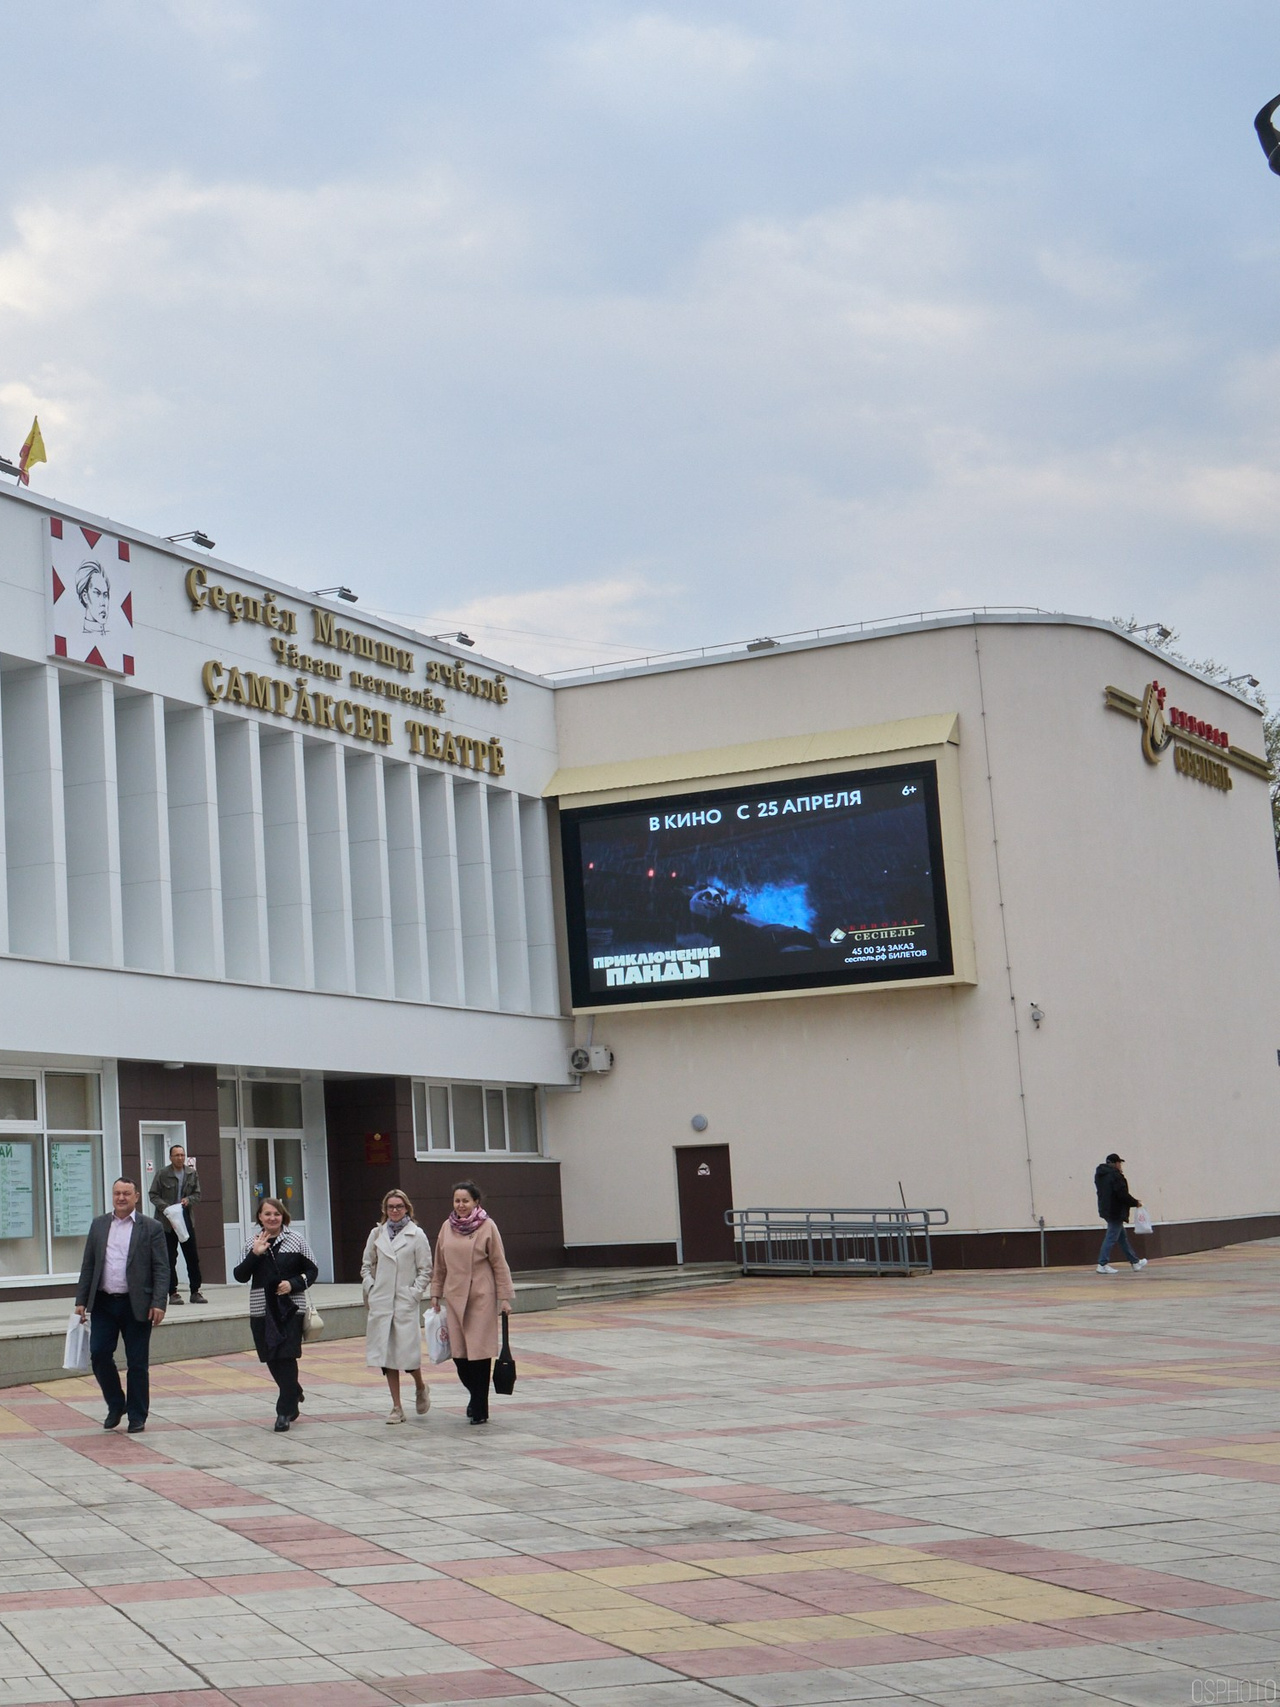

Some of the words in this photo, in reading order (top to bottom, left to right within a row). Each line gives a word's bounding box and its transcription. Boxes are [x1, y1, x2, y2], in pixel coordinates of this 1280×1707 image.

[311, 607, 415, 673] Мишши
[901, 785, 917, 796] 6+
[649, 816, 660, 832] В
[664, 809, 722, 830] КИНО
[736, 804, 750, 820] С
[757, 800, 779, 818] 25
[782, 790, 862, 815] АПРЕЛЯ
[854, 928, 916, 941] СЕСПЕЛЬ
[593, 945, 721, 969] ПРИКЛЮЧЕНИЯ
[852, 947, 862, 955] 45
[863, 946, 875, 954] 00
[875, 945, 886, 953] 34
[887, 942, 915, 952] ЗАКАЗ
[888, 949, 928, 960] БИЛЕТОВ
[606, 960, 709, 987] ПАНДЫ
